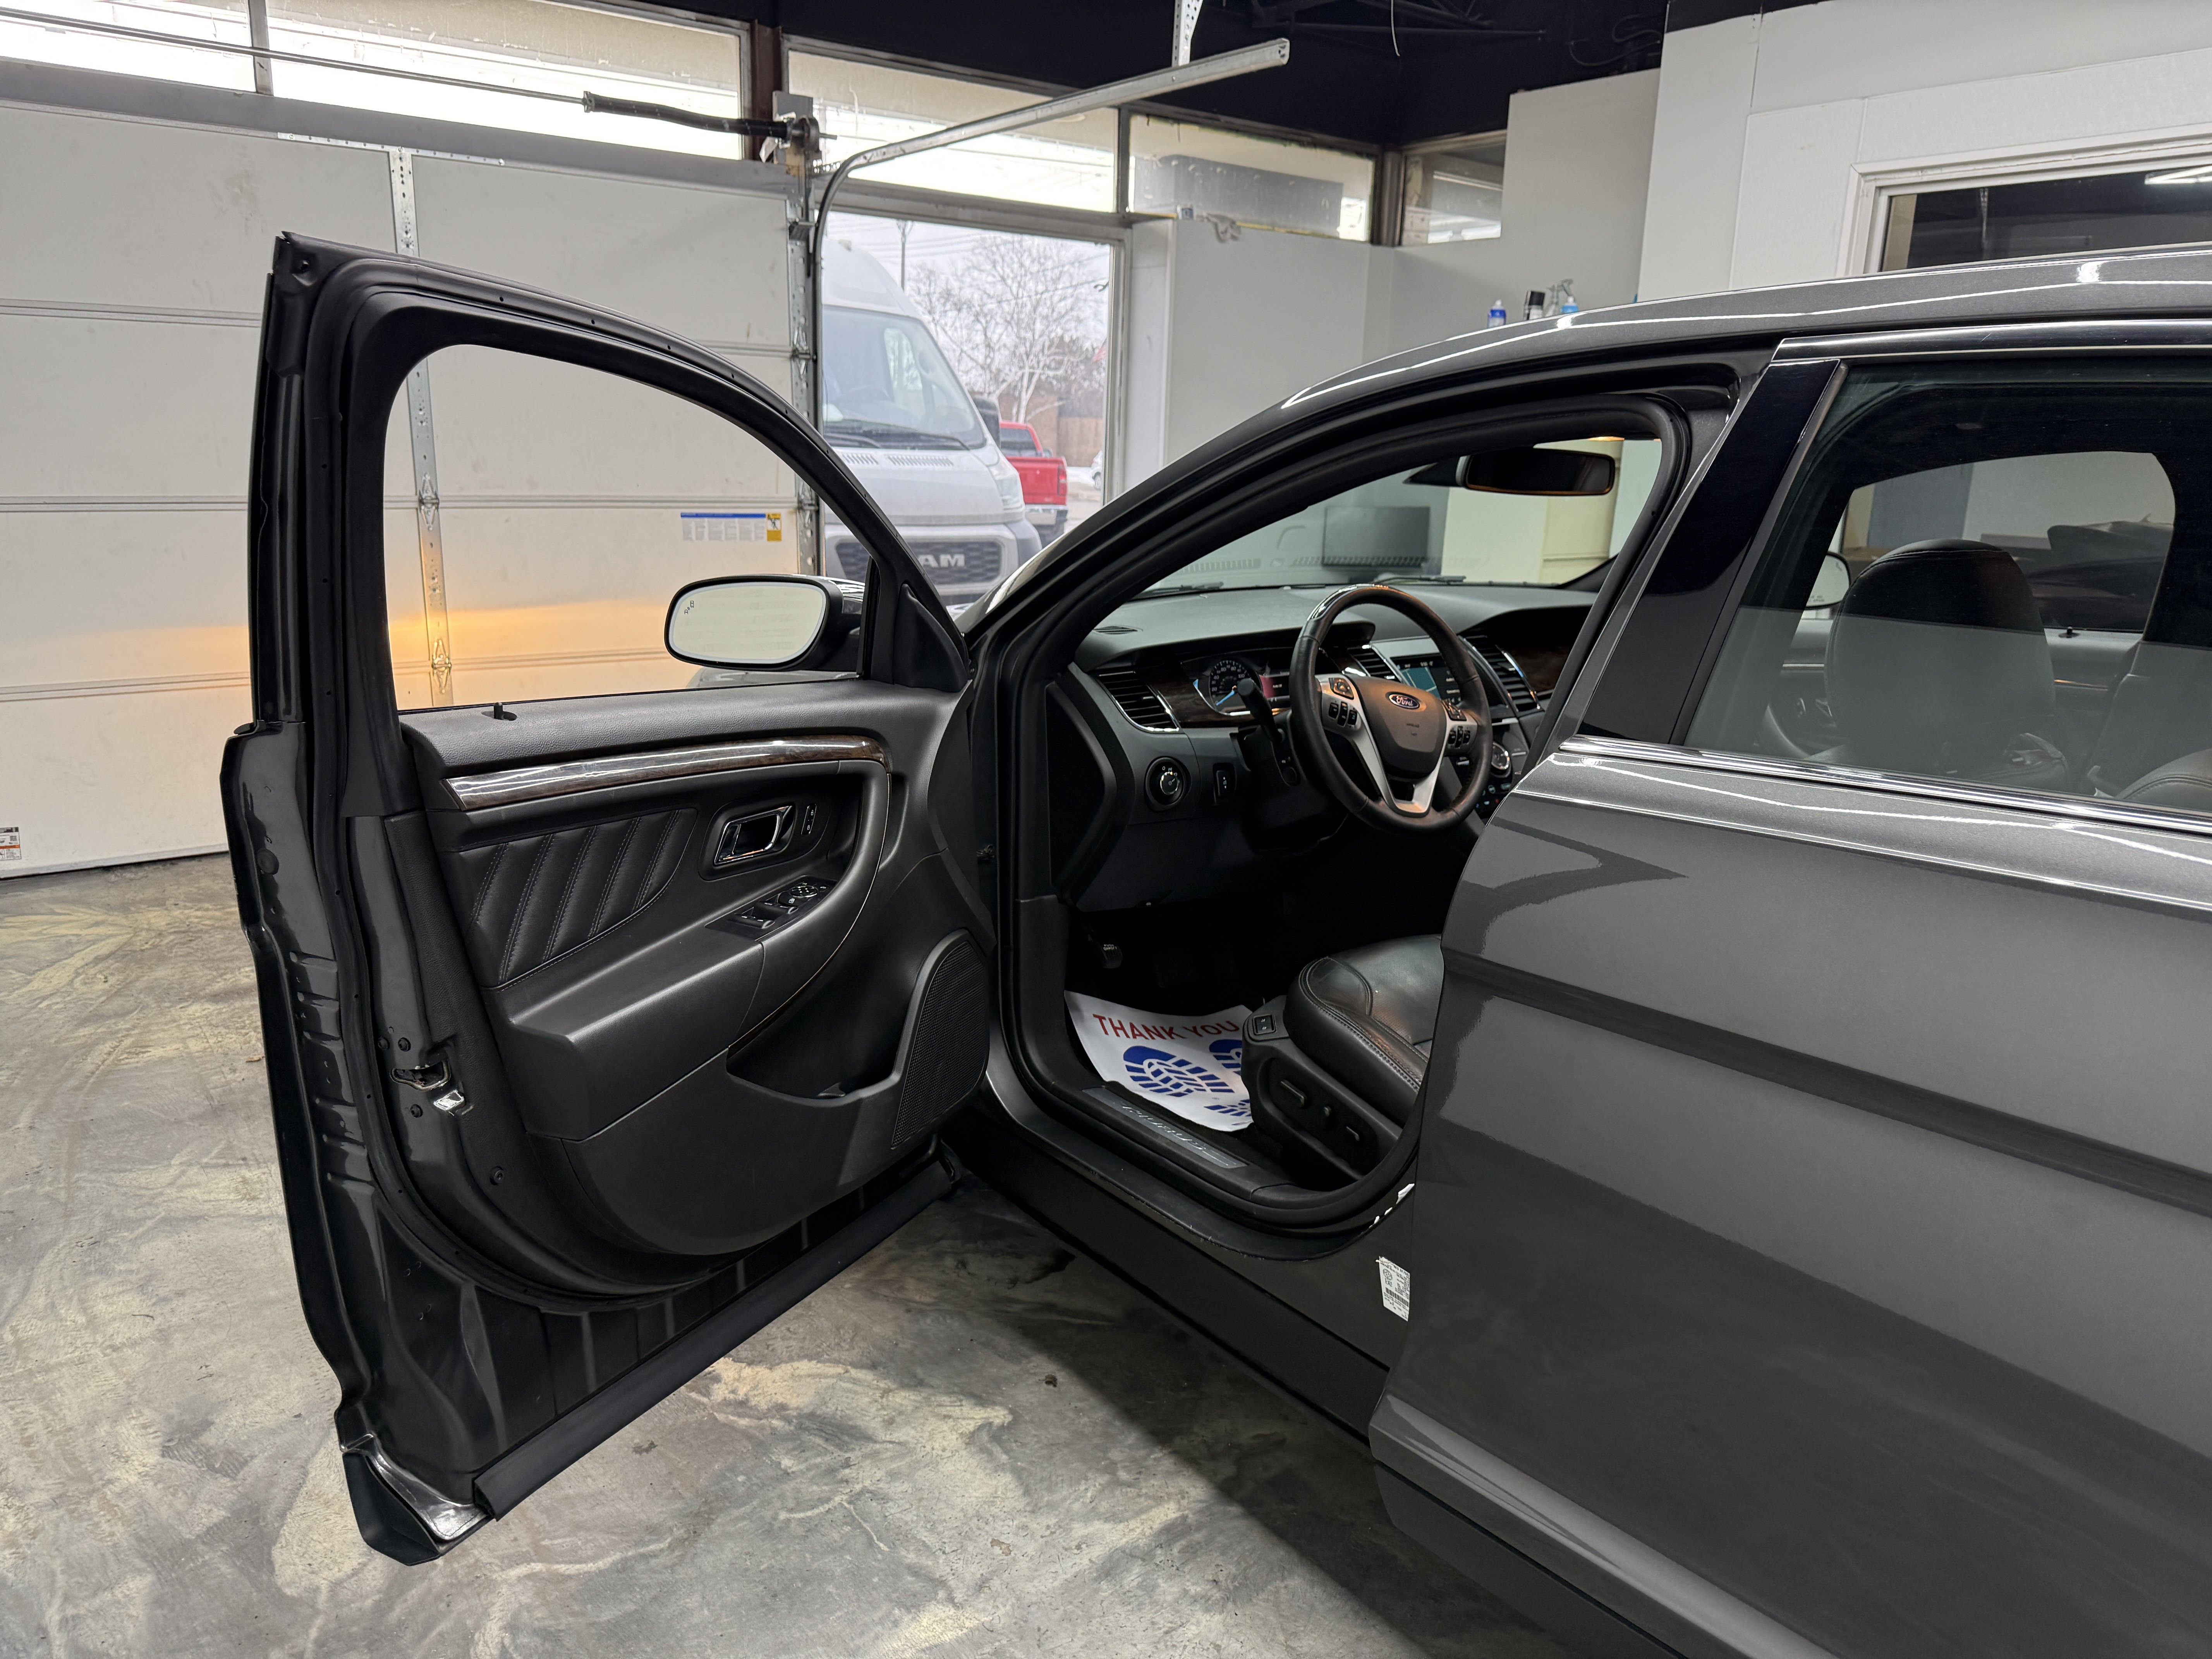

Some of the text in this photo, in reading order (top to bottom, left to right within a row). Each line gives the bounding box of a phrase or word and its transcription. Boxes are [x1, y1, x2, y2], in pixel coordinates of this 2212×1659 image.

[918, 554, 965, 567] AM
[1093, 1014, 1240, 1040] THANK YOU
